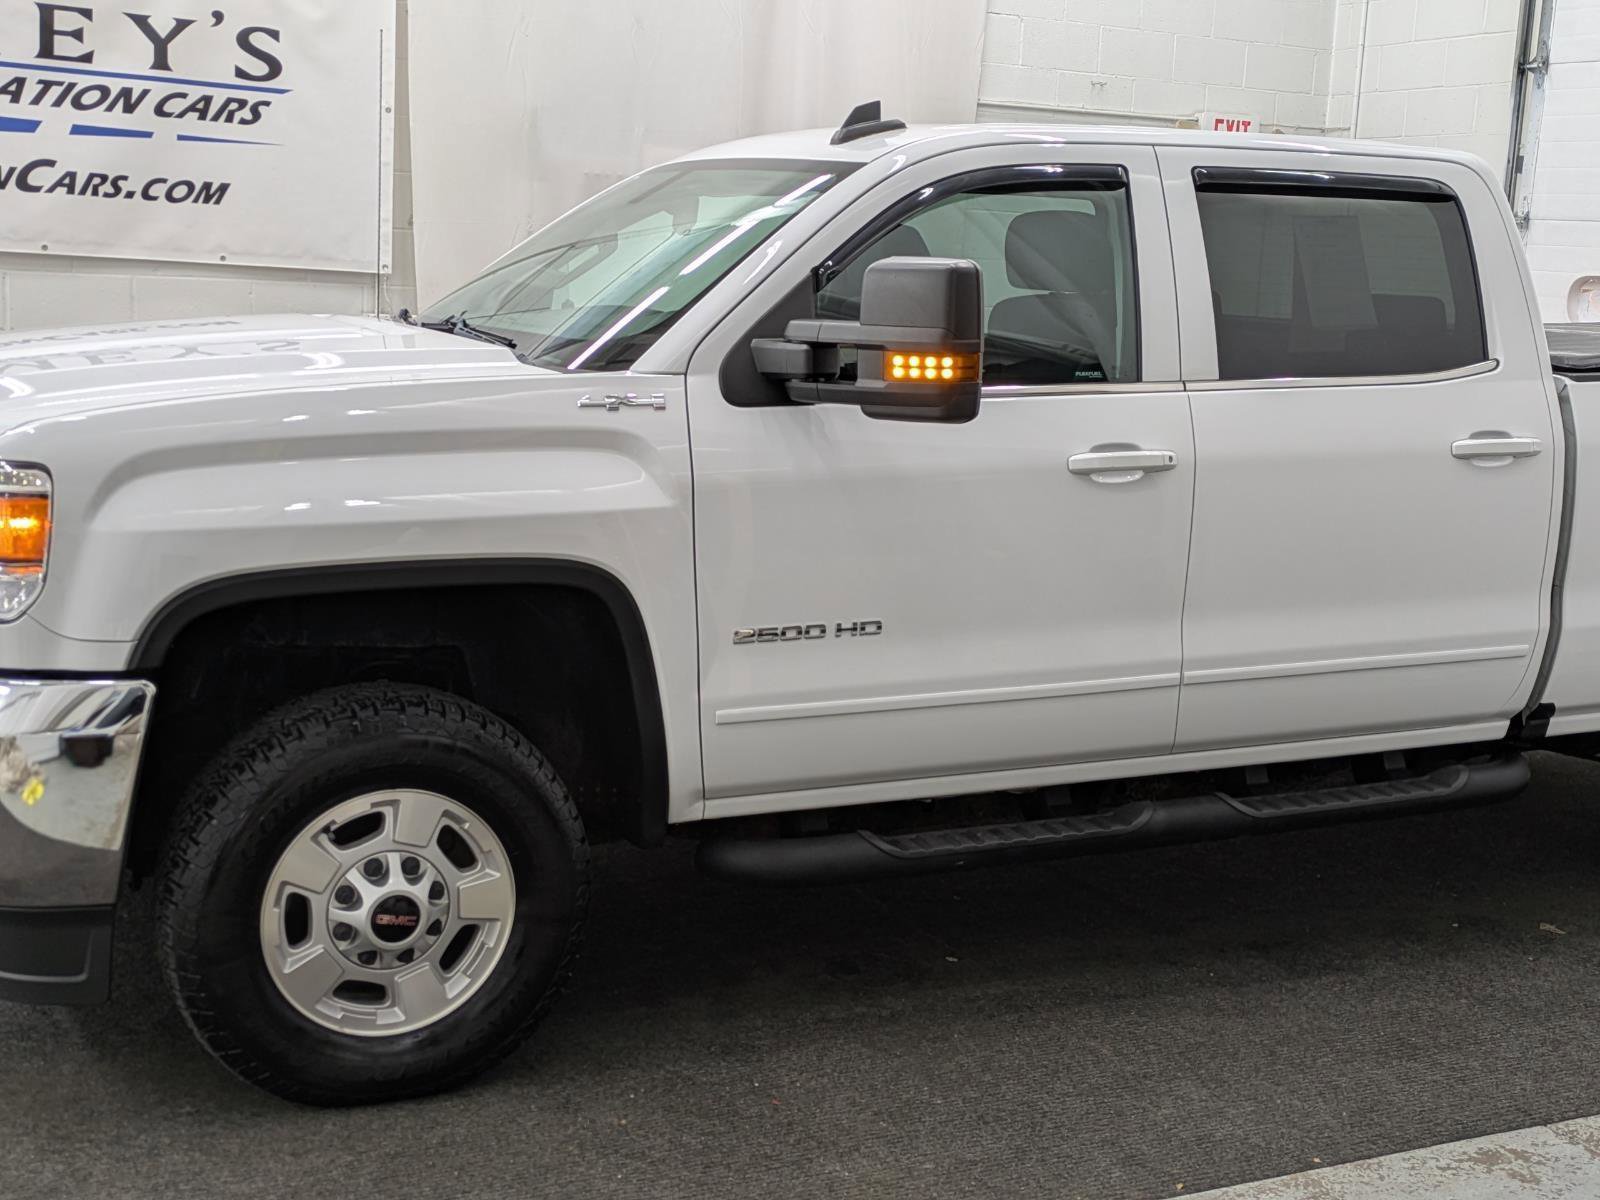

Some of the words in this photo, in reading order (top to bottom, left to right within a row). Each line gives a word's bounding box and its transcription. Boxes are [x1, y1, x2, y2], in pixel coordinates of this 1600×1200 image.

[0, 77, 151, 115] ATION
[153, 91, 272, 126] CARS
[733, 624, 827, 645] 2500
[834, 620, 882, 638] HD
[375, 914, 418, 926] GMC
